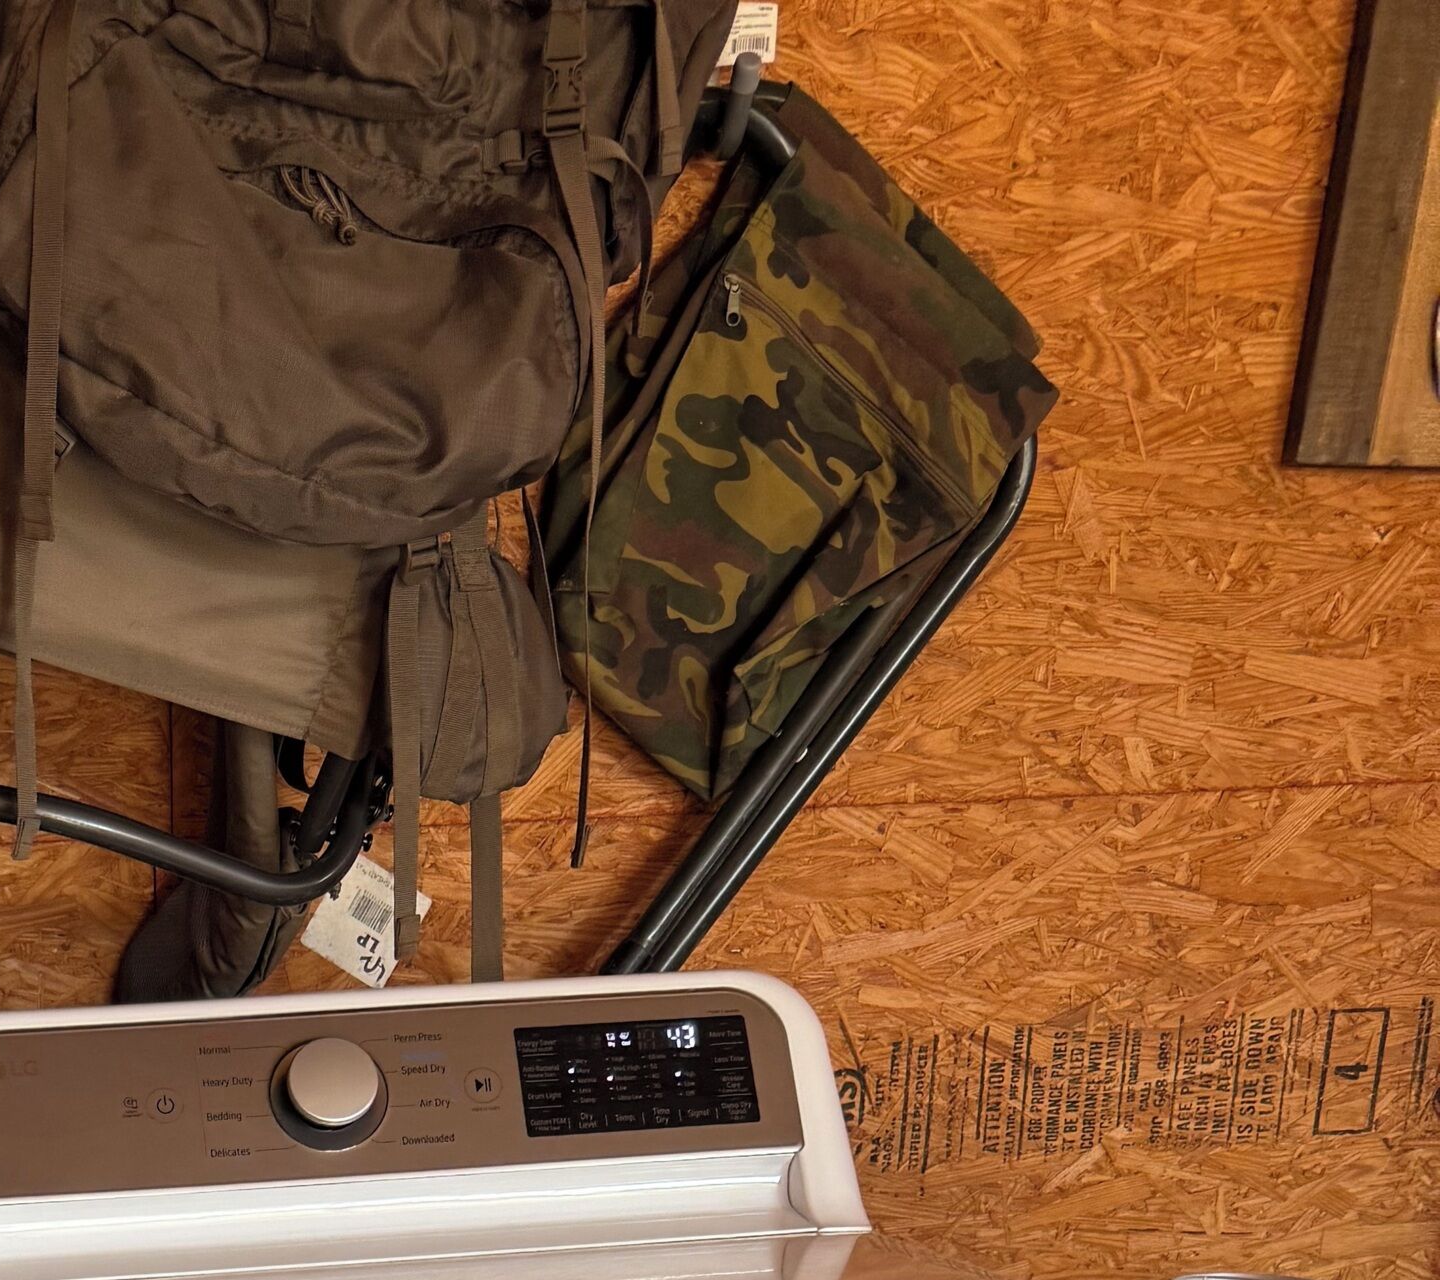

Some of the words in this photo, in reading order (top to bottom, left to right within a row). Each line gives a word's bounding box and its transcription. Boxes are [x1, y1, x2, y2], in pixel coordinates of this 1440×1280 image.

[393, 1033, 417, 1043] Perm
[418, 1031, 442, 1041] Press
[666, 1023, 697, 1049] 43
[1244, 1018, 1268, 1071] DOWN
[198, 1046, 231, 1056] Normal
[1051, 1031, 1069, 1078] PANELS
[1087, 1040, 1105, 1074] WITH
[400, 1065, 428, 1076] Speed
[430, 1063, 446, 1075] Dry
[1179, 1036, 1201, 1096] PANELS
[1333, 1061, 1369, 1081] 4
[202, 1078, 230, 1088] Heavy
[231, 1076, 254, 1087] Duty
[1030, 1064, 1049, 1112] PROPER
[1064, 1047, 1085, 1113] INSTALLED
[1197, 1071, 1213, 1090] AT
[1215, 1073, 1231, 1093] AT
[419, 1098, 432, 1108] Air
[434, 1098, 451, 1109] Dry
[1239, 1077, 1260, 1117] SIDE
[206, 1111, 242, 1122] Bedding
[1044, 1081, 1064, 1156] RFORMANCE
[1192, 1095, 1212, 1131] INCH
[1027, 1117, 1043, 1141] FOR
[1063, 1117, 1079, 1133] BE
[401, 1133, 455, 1146] Downloaded
[210, 1147, 251, 1158] Delicates
